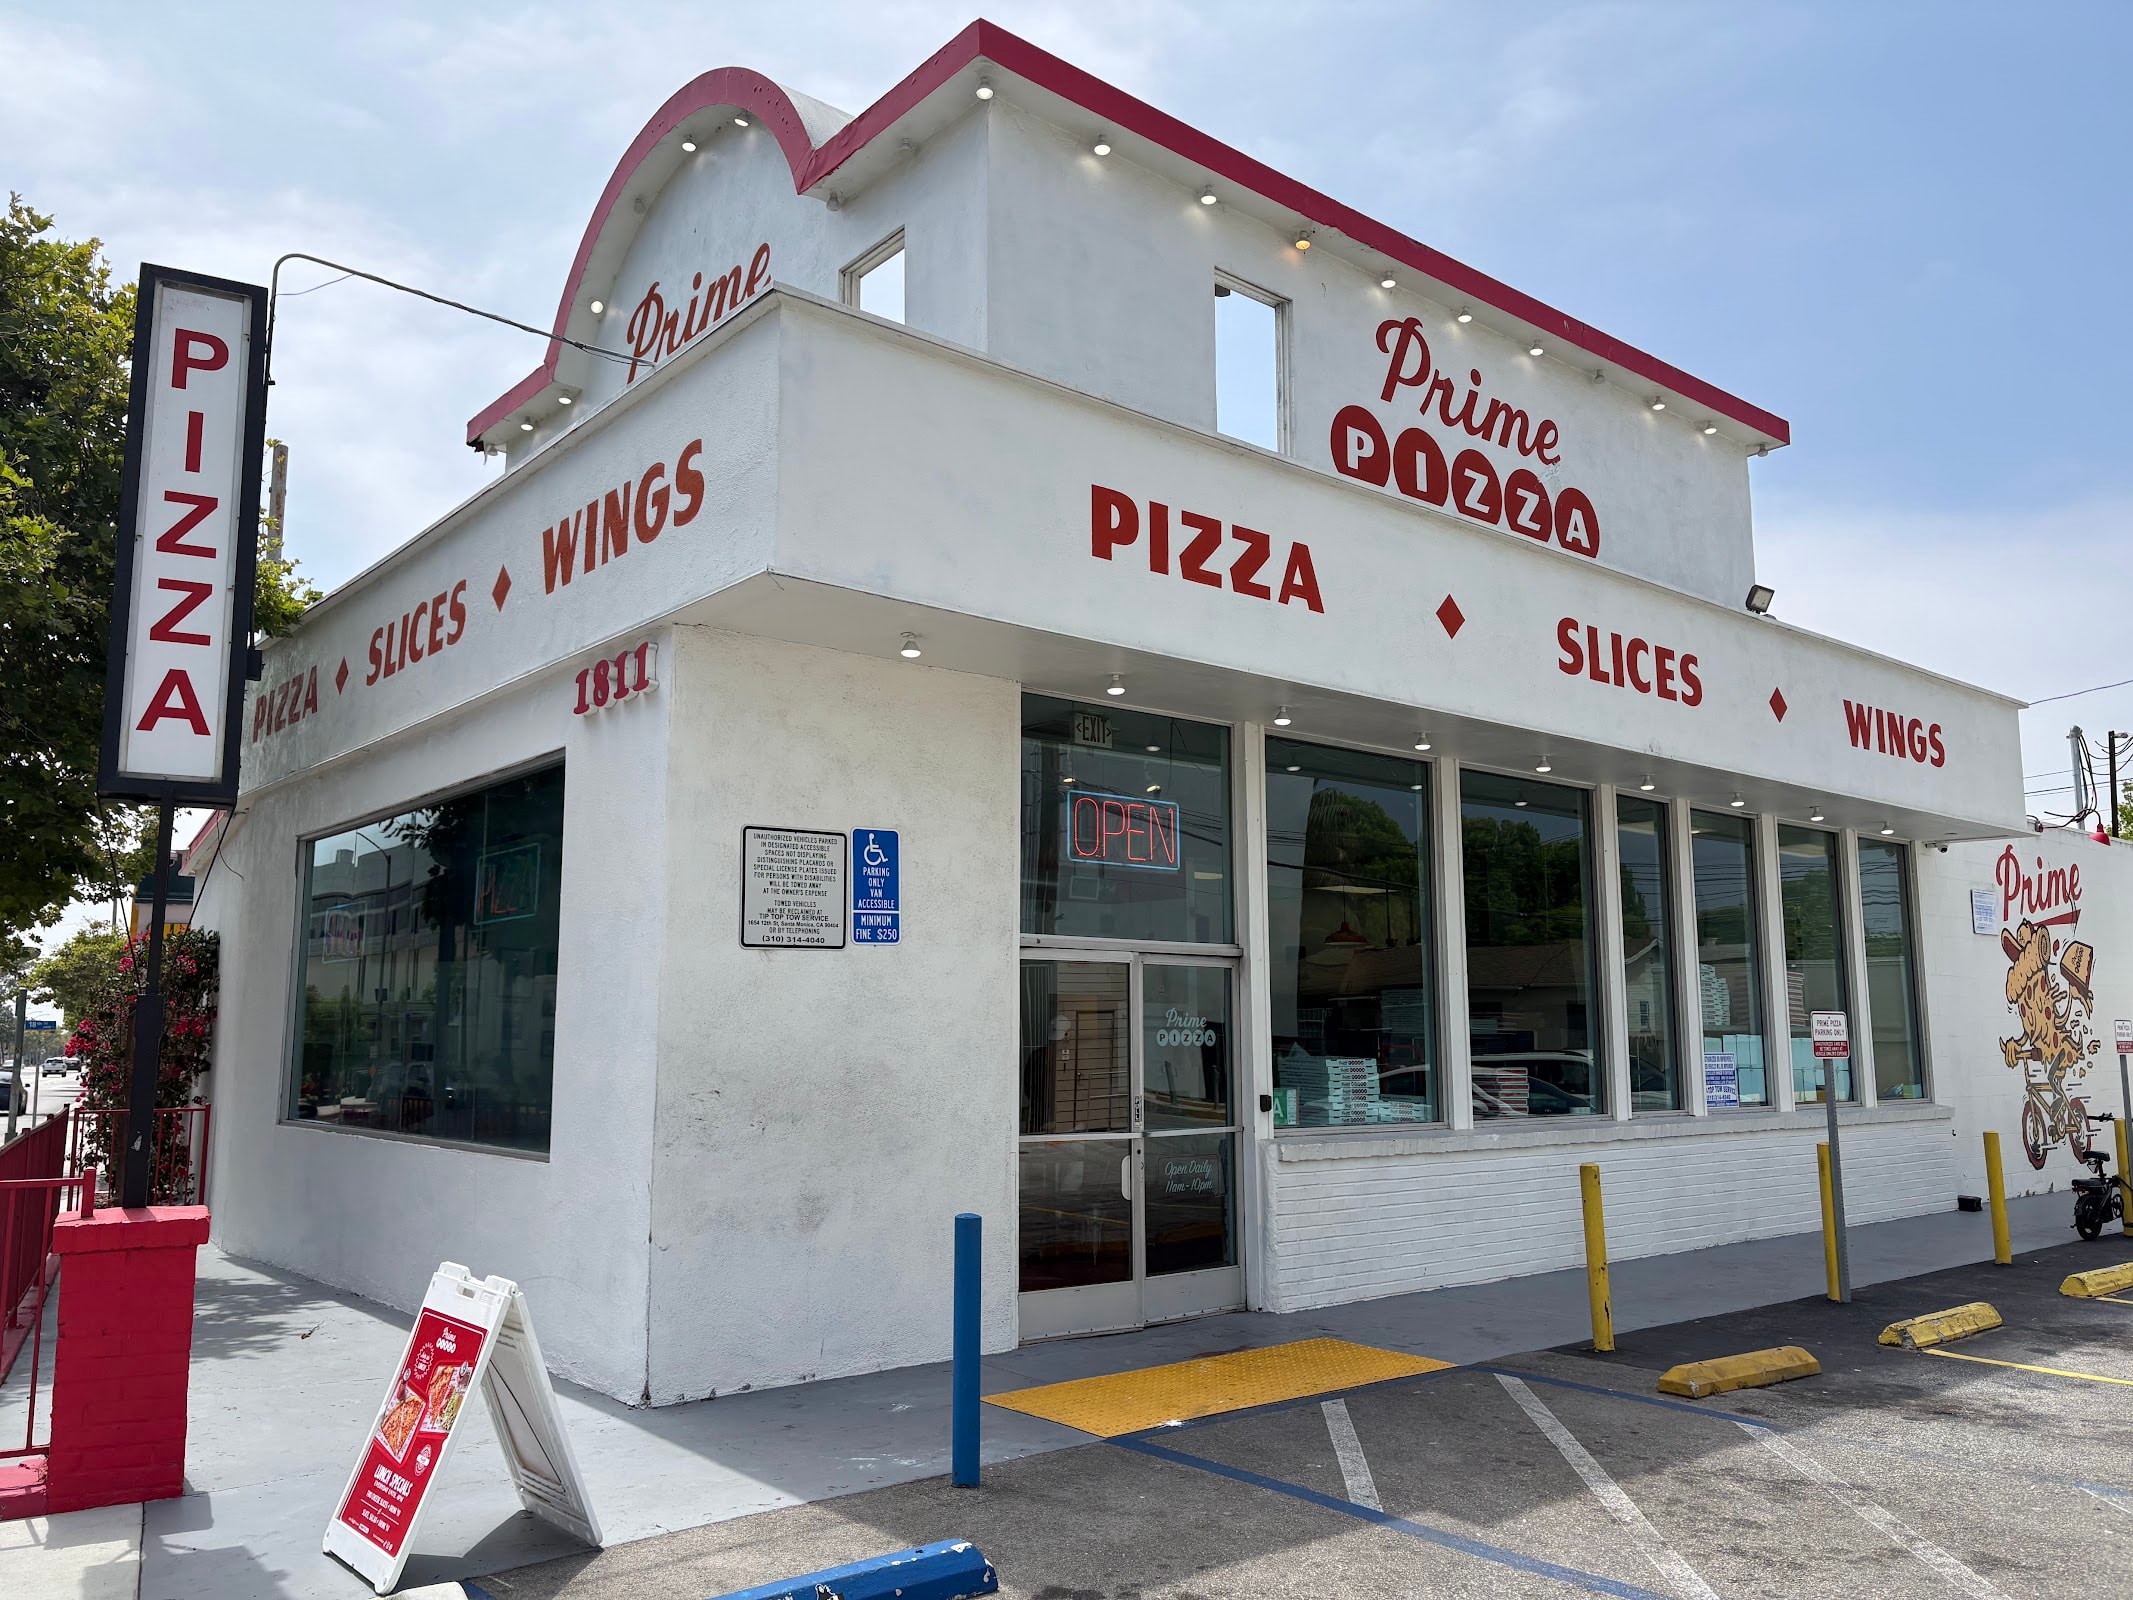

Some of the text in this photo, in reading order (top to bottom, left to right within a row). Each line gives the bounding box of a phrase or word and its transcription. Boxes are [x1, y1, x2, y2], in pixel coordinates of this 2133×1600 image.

[627, 242, 771, 385] Prime
[1376, 317, 1560, 465] Prime
[1337, 413, 1595, 553] PIZZA
[136, 328, 229, 736] PIZZA
[252, 439, 705, 742] PIZZA SLICES WINGS
[1091, 484, 1946, 768] PIZZA SLICES WINGS
[573, 641, 651, 715] 1811
[1083, 717, 1107, 744] EXIT
[754, 833, 792, 842] UNAUTHORIZED
[794, 836, 817, 844] VEHICLES
[1074, 798, 1175, 864] OPEN
[768, 842, 798, 850] DESIGNATED
[800, 844, 830, 852] ACCESSIBLE
[798, 851, 826, 859] DISPLAYING
[757, 857, 797, 865] DISTINGUISHING
[766, 872, 789, 880] PERSONS
[804, 874, 836, 882] DISABILITIES
[863, 867, 890, 876] PARKING
[868, 878, 884, 887] ONLY
[1995, 844, 2083, 922] Prime
[870, 889, 883, 897] VAN
[858, 899, 894, 909] ACCESSIBLE
[861, 914, 892, 926] MINIMUM
[856, 928, 897, 940] FINE $250
[1166, 1008, 1208, 1028] Prime
[1158, 1031, 1215, 1045] PIZZA
[1274, 1097, 1284, 1117] A
[1165, 1160, 1212, 1179] Open Daily
[374, 1464, 413, 1497] LUNCH SPECIALS
